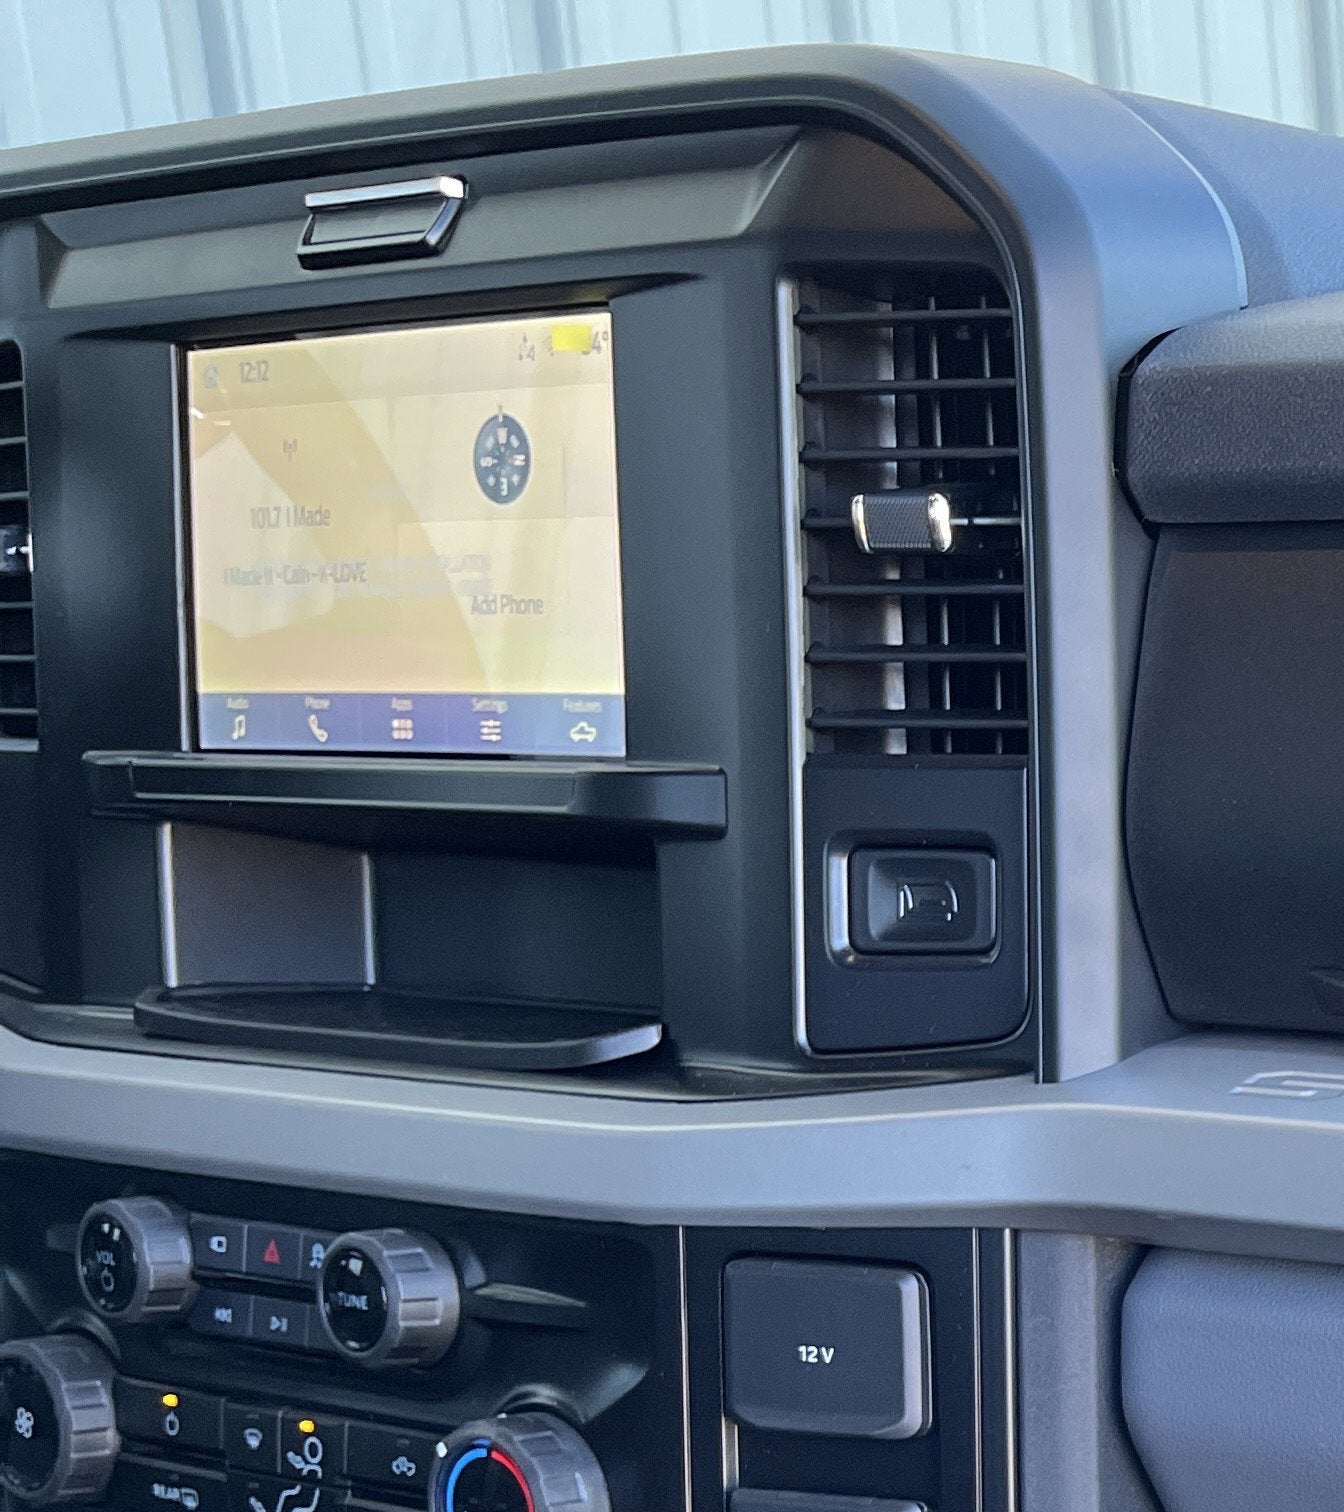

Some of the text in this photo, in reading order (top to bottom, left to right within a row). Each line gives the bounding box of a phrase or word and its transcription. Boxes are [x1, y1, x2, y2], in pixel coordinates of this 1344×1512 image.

[239, 360, 270, 383] 12:12
[471, 594, 544, 615] Add Phone
